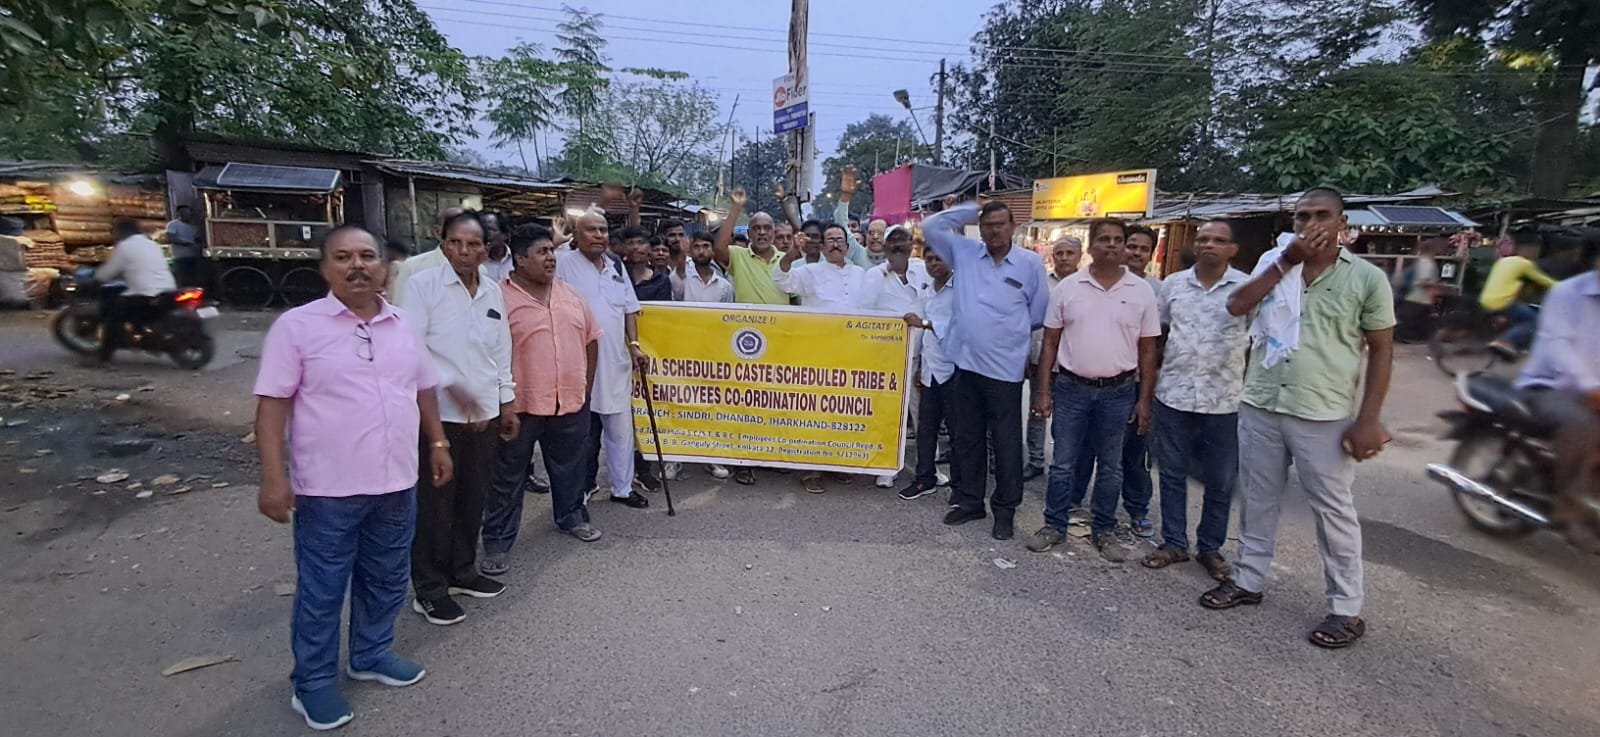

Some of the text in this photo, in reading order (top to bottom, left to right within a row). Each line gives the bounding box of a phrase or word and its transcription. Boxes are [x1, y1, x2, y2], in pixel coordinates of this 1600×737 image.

[722, 314, 767, 324] ORGANIZE
[846, 321, 853, 329] &
[855, 321, 891, 331] AGITATE
[662, 358, 731, 380] SCHEDULED
[851, 370, 885, 390] TRIBE
[889, 372, 897, 390] &
[652, 383, 721, 404] EMPLOYEES
[724, 388, 817, 412] CO-ORDINATION
[820, 394, 873, 416] COUNCIL
[678, 410, 713, 421] SINDRI,
[716, 412, 766, 425] DHANBAD,
[681, 440, 711, 449] Ganguly
[738, 433, 775, 443] Employees
[827, 440, 854, 449] Council
